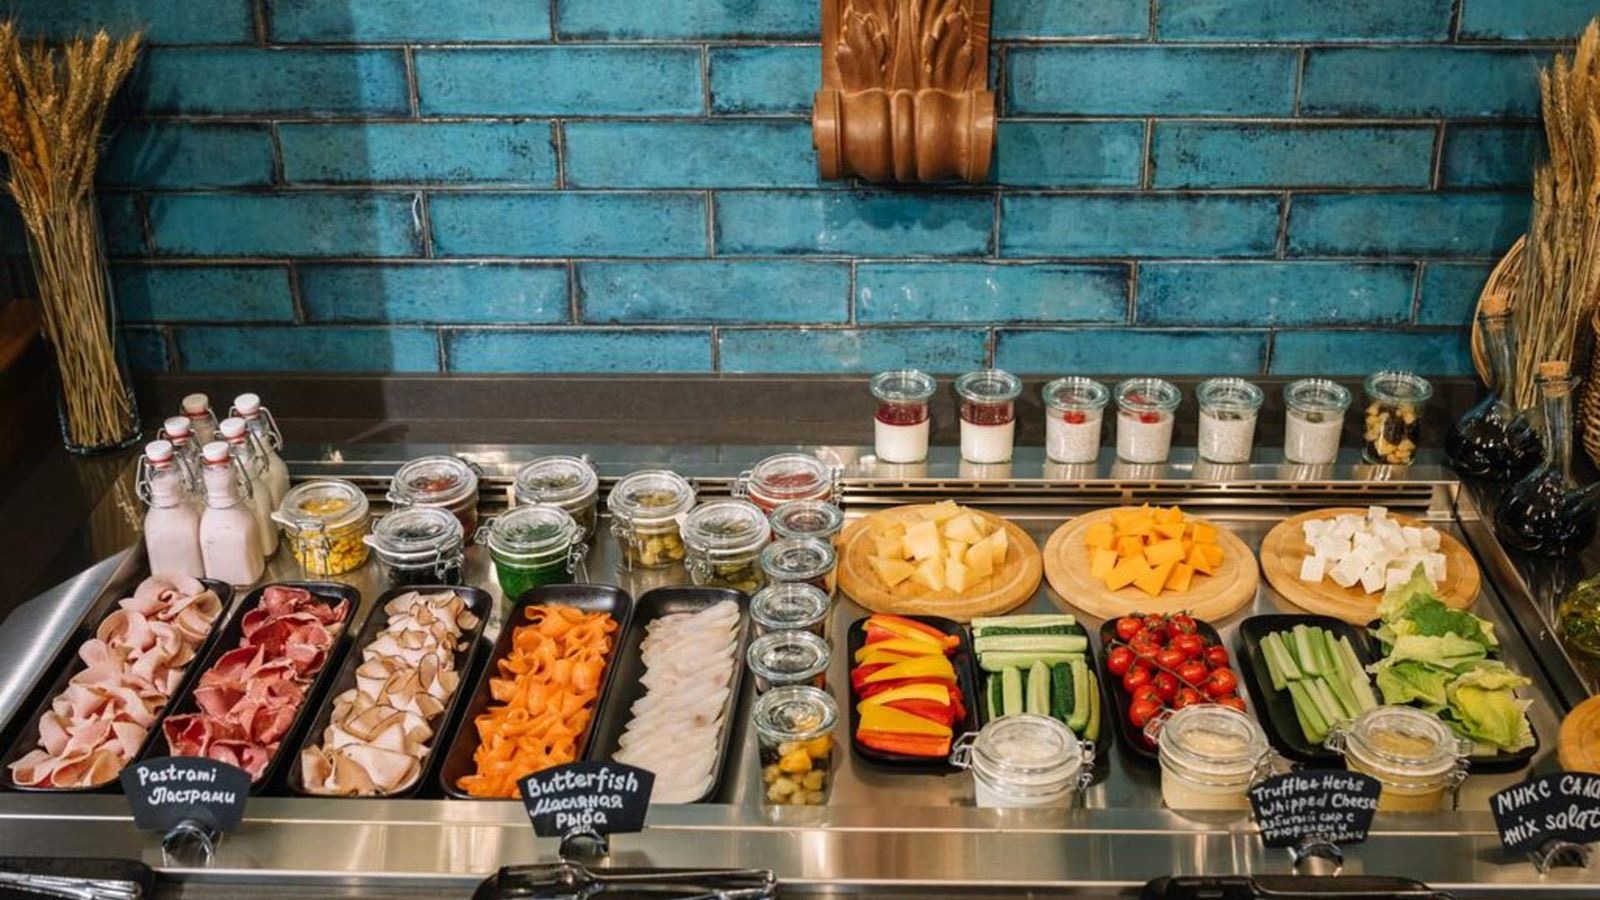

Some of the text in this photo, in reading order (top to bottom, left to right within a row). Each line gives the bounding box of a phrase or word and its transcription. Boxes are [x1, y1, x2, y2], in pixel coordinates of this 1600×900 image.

[137, 764, 217, 786] Pastrami
[527, 767, 639, 797] Butterfish
[1322, 775, 1364, 792] Herbs
[148, 787, 236, 805] Пастрами
[529, 795, 623, 817] Масляная
[1331, 793, 1377, 810] Cheese
[1504, 815, 1540, 846] mix
